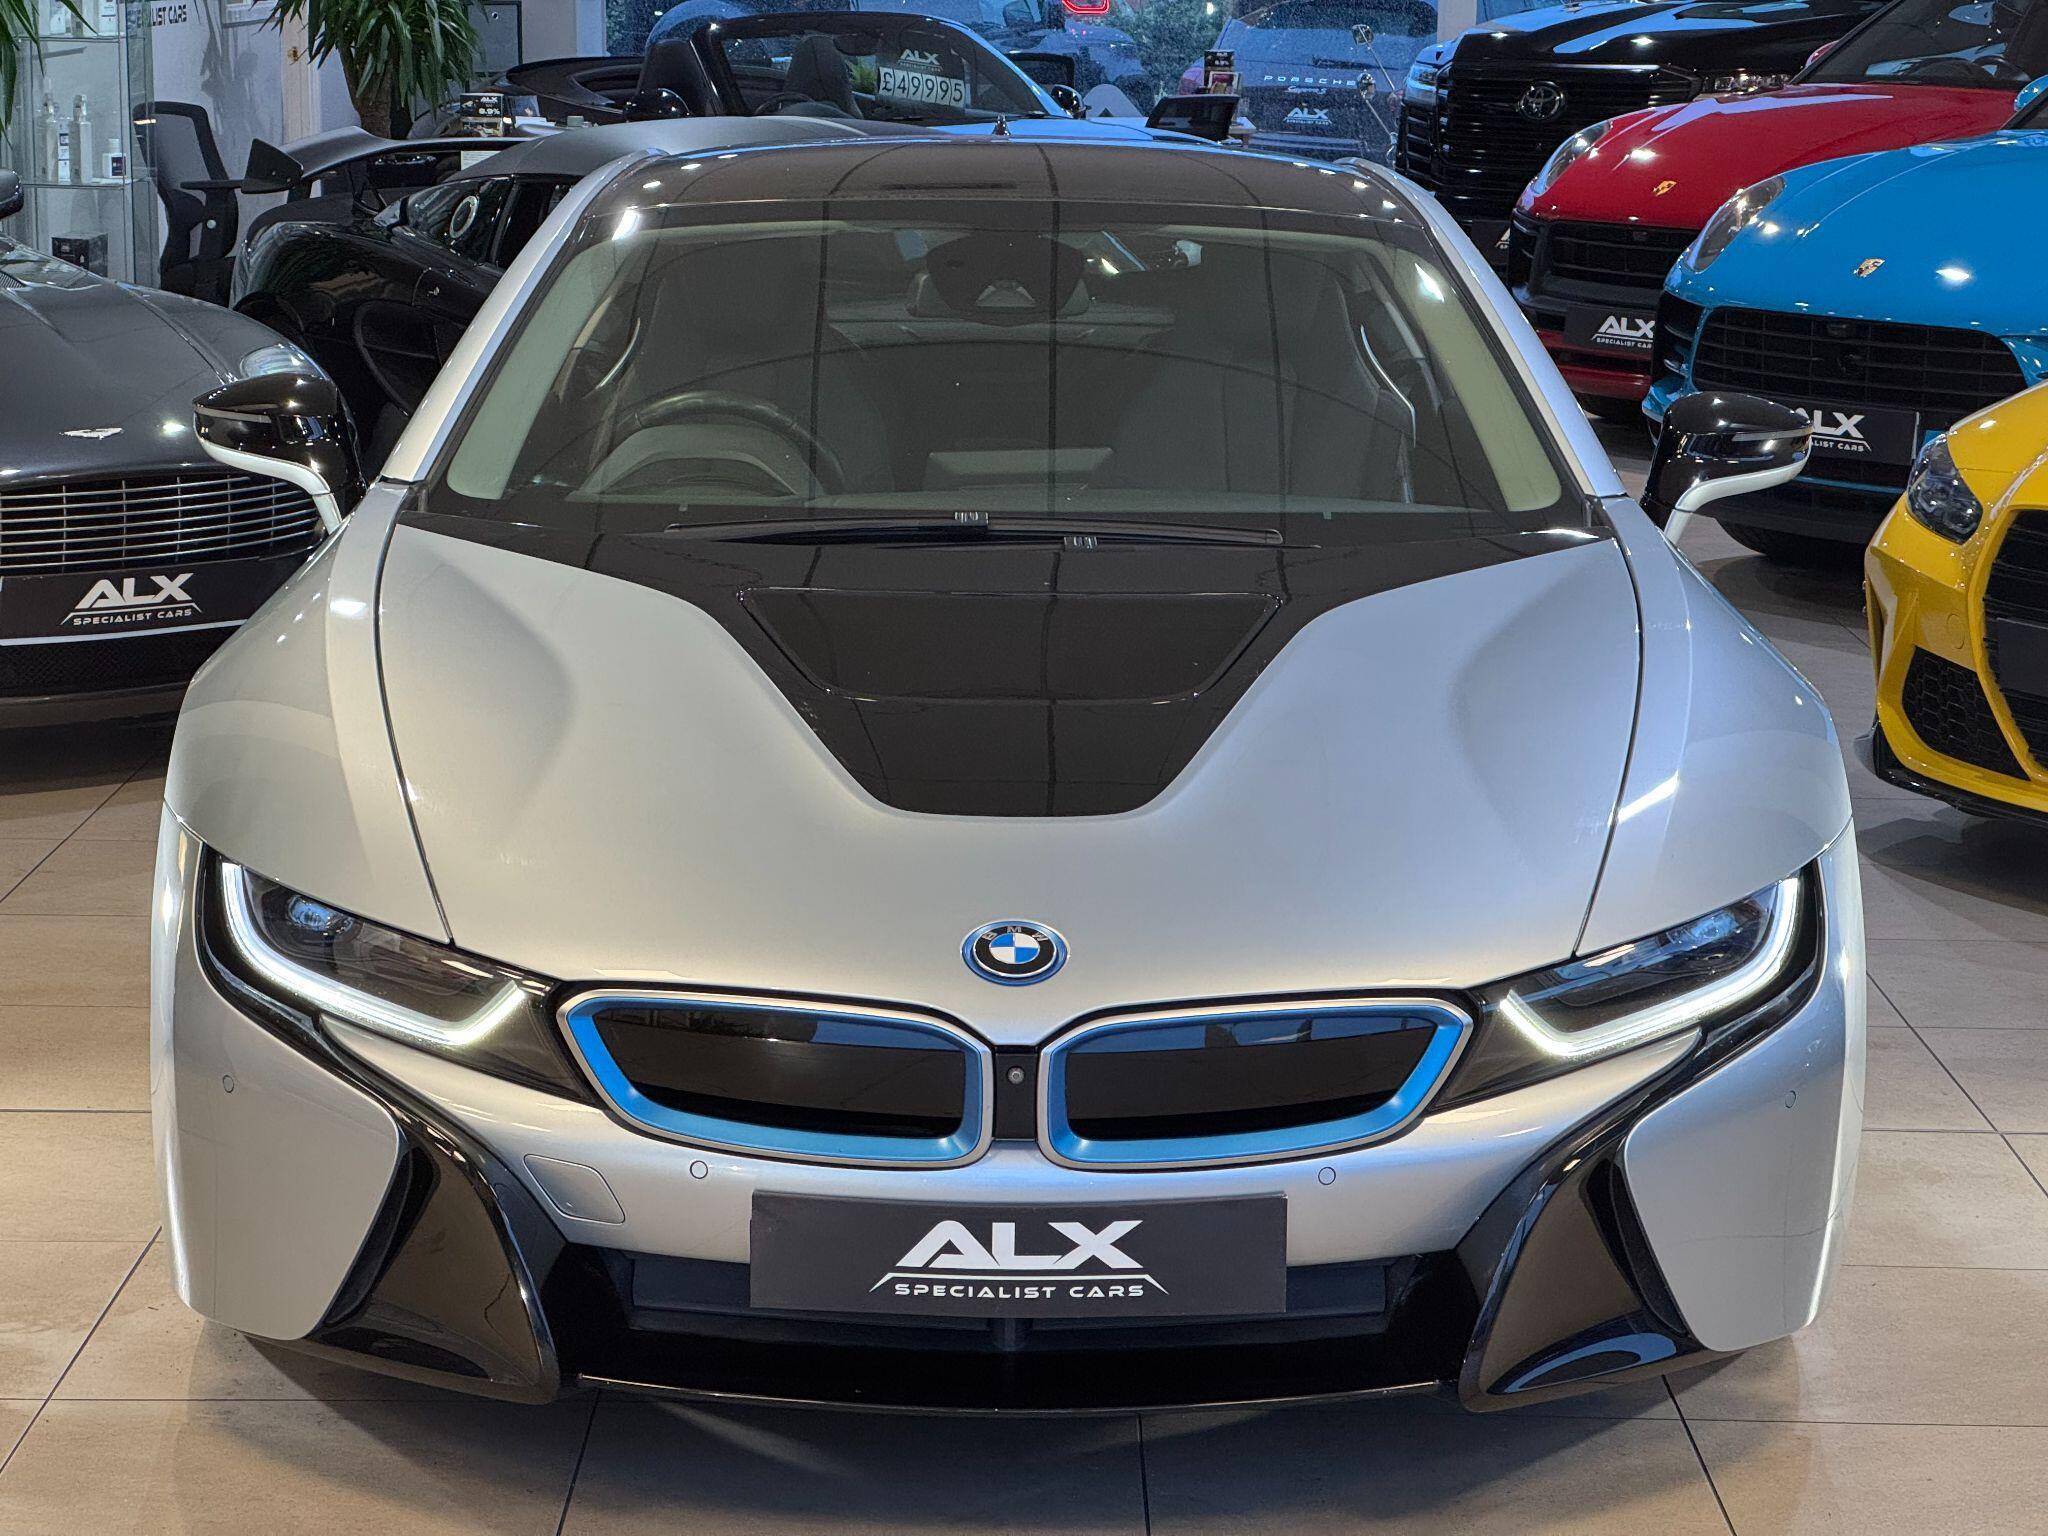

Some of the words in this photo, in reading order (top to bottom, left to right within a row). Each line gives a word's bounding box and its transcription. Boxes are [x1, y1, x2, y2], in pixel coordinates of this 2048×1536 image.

[168, 4, 188, 24] CARS
[900, 48, 940, 65] ALX
[881, 71, 963, 103] £49995
[1263, 75, 1357, 86] PORSCHE
[1287, 106, 1329, 120] ALX
[1597, 315, 1656, 339] ALX
[1596, 337, 1636, 347] SPECIALIST
[1837, 443, 1865, 453] CARS
[75, 572, 194, 609] ALX
[73, 612, 152, 626] SPECIALIST
[157, 608, 192, 619] CARS
[982, 926, 1049, 942] BMW
[895, 1220, 1144, 1270] ALX
[894, 1283, 1057, 1300] SPECIALIST
[1069, 1284, 1145, 1299] CARS
